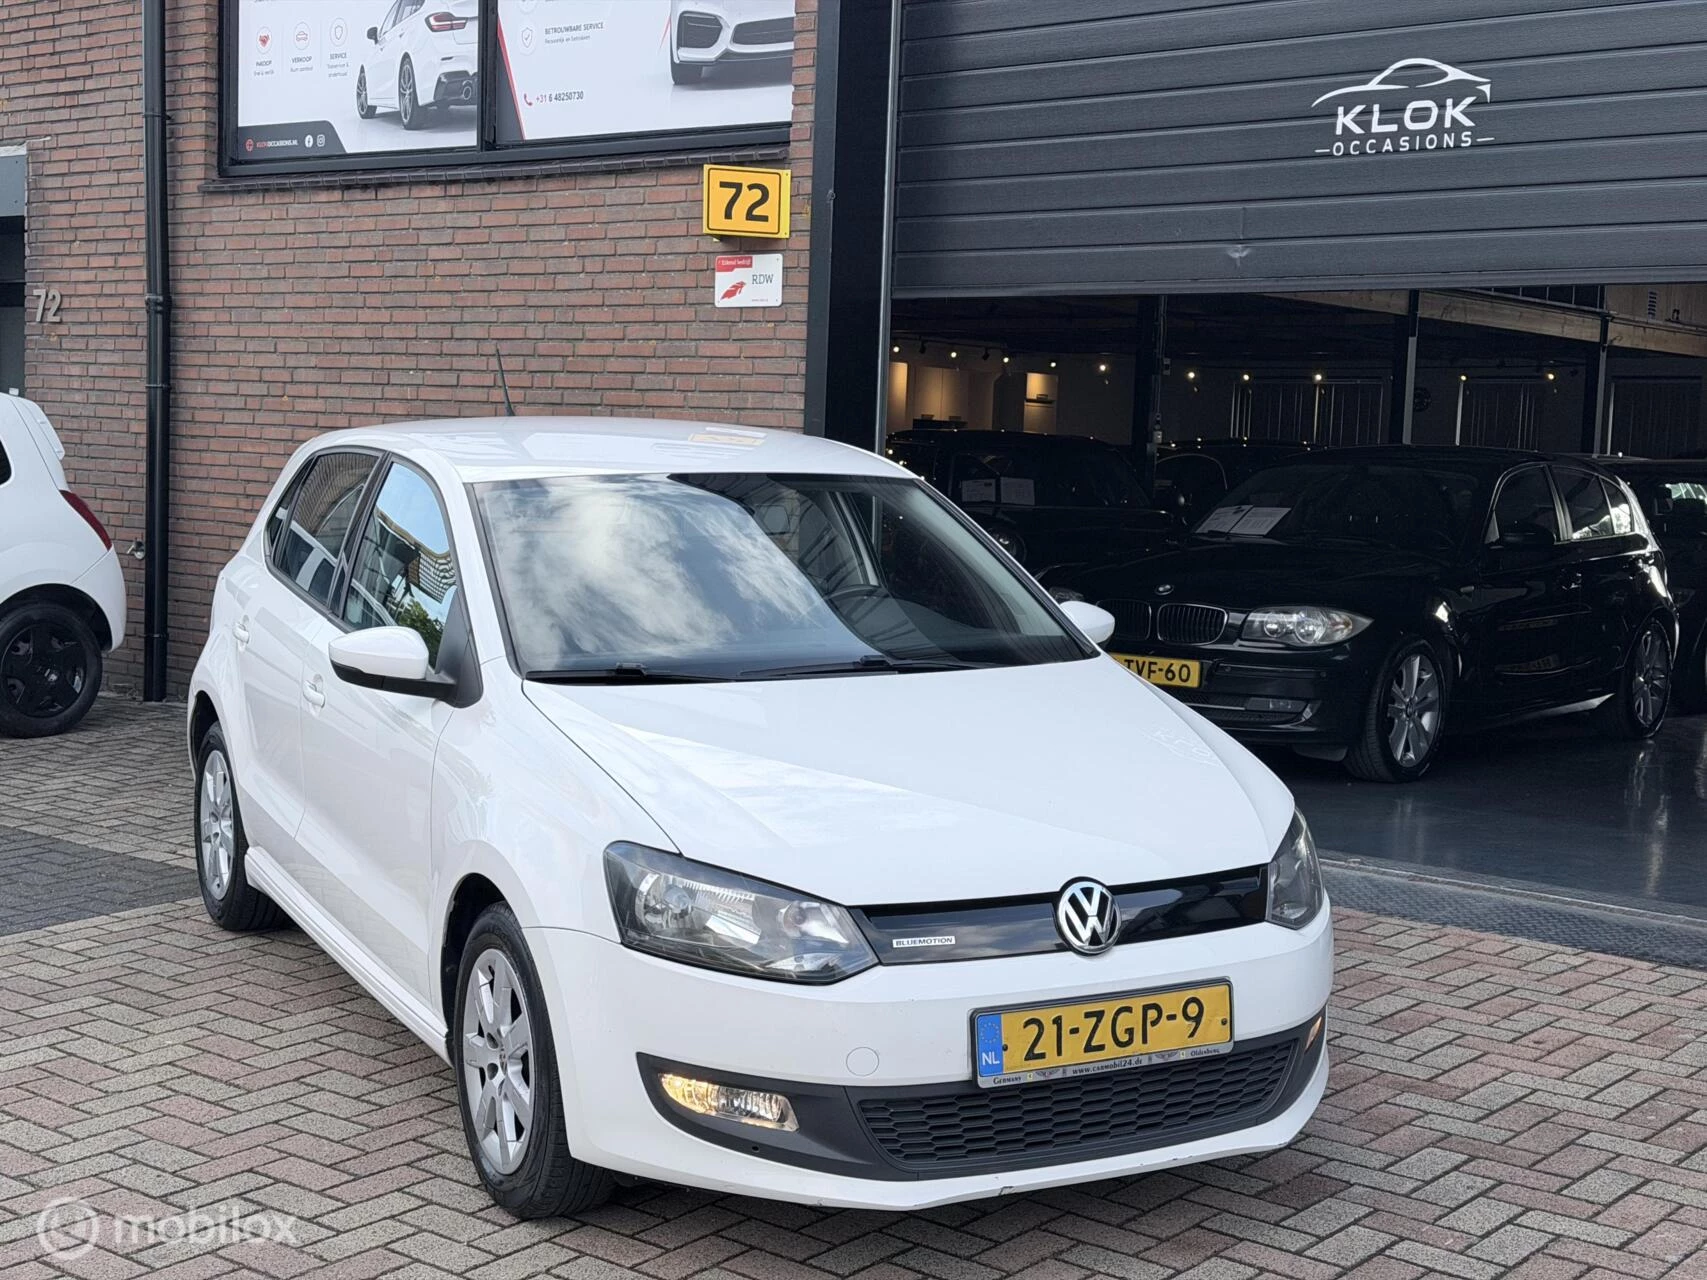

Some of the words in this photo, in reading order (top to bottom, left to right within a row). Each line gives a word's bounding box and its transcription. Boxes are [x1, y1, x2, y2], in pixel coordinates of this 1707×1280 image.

[545, 24, 582, 35] BETROUWBARE
[583, 22, 604, 31] SERVICE
[536, 94, 547, 103] +31
[548, 93, 553, 102] 6
[554, 91, 584, 101] 48250730
[1335, 96, 1477, 135] KLOK
[1332, 131, 1472, 156] OCCASIONS
[719, 181, 770, 222] 72
[751, 273, 774, 285] RDW
[33, 288, 61, 322] 72
[895, 937, 953, 947] BLUEMOTION
[1022, 996, 1205, 1062] 21-ZGP-9
[982, 1051, 1000, 1066] NL
